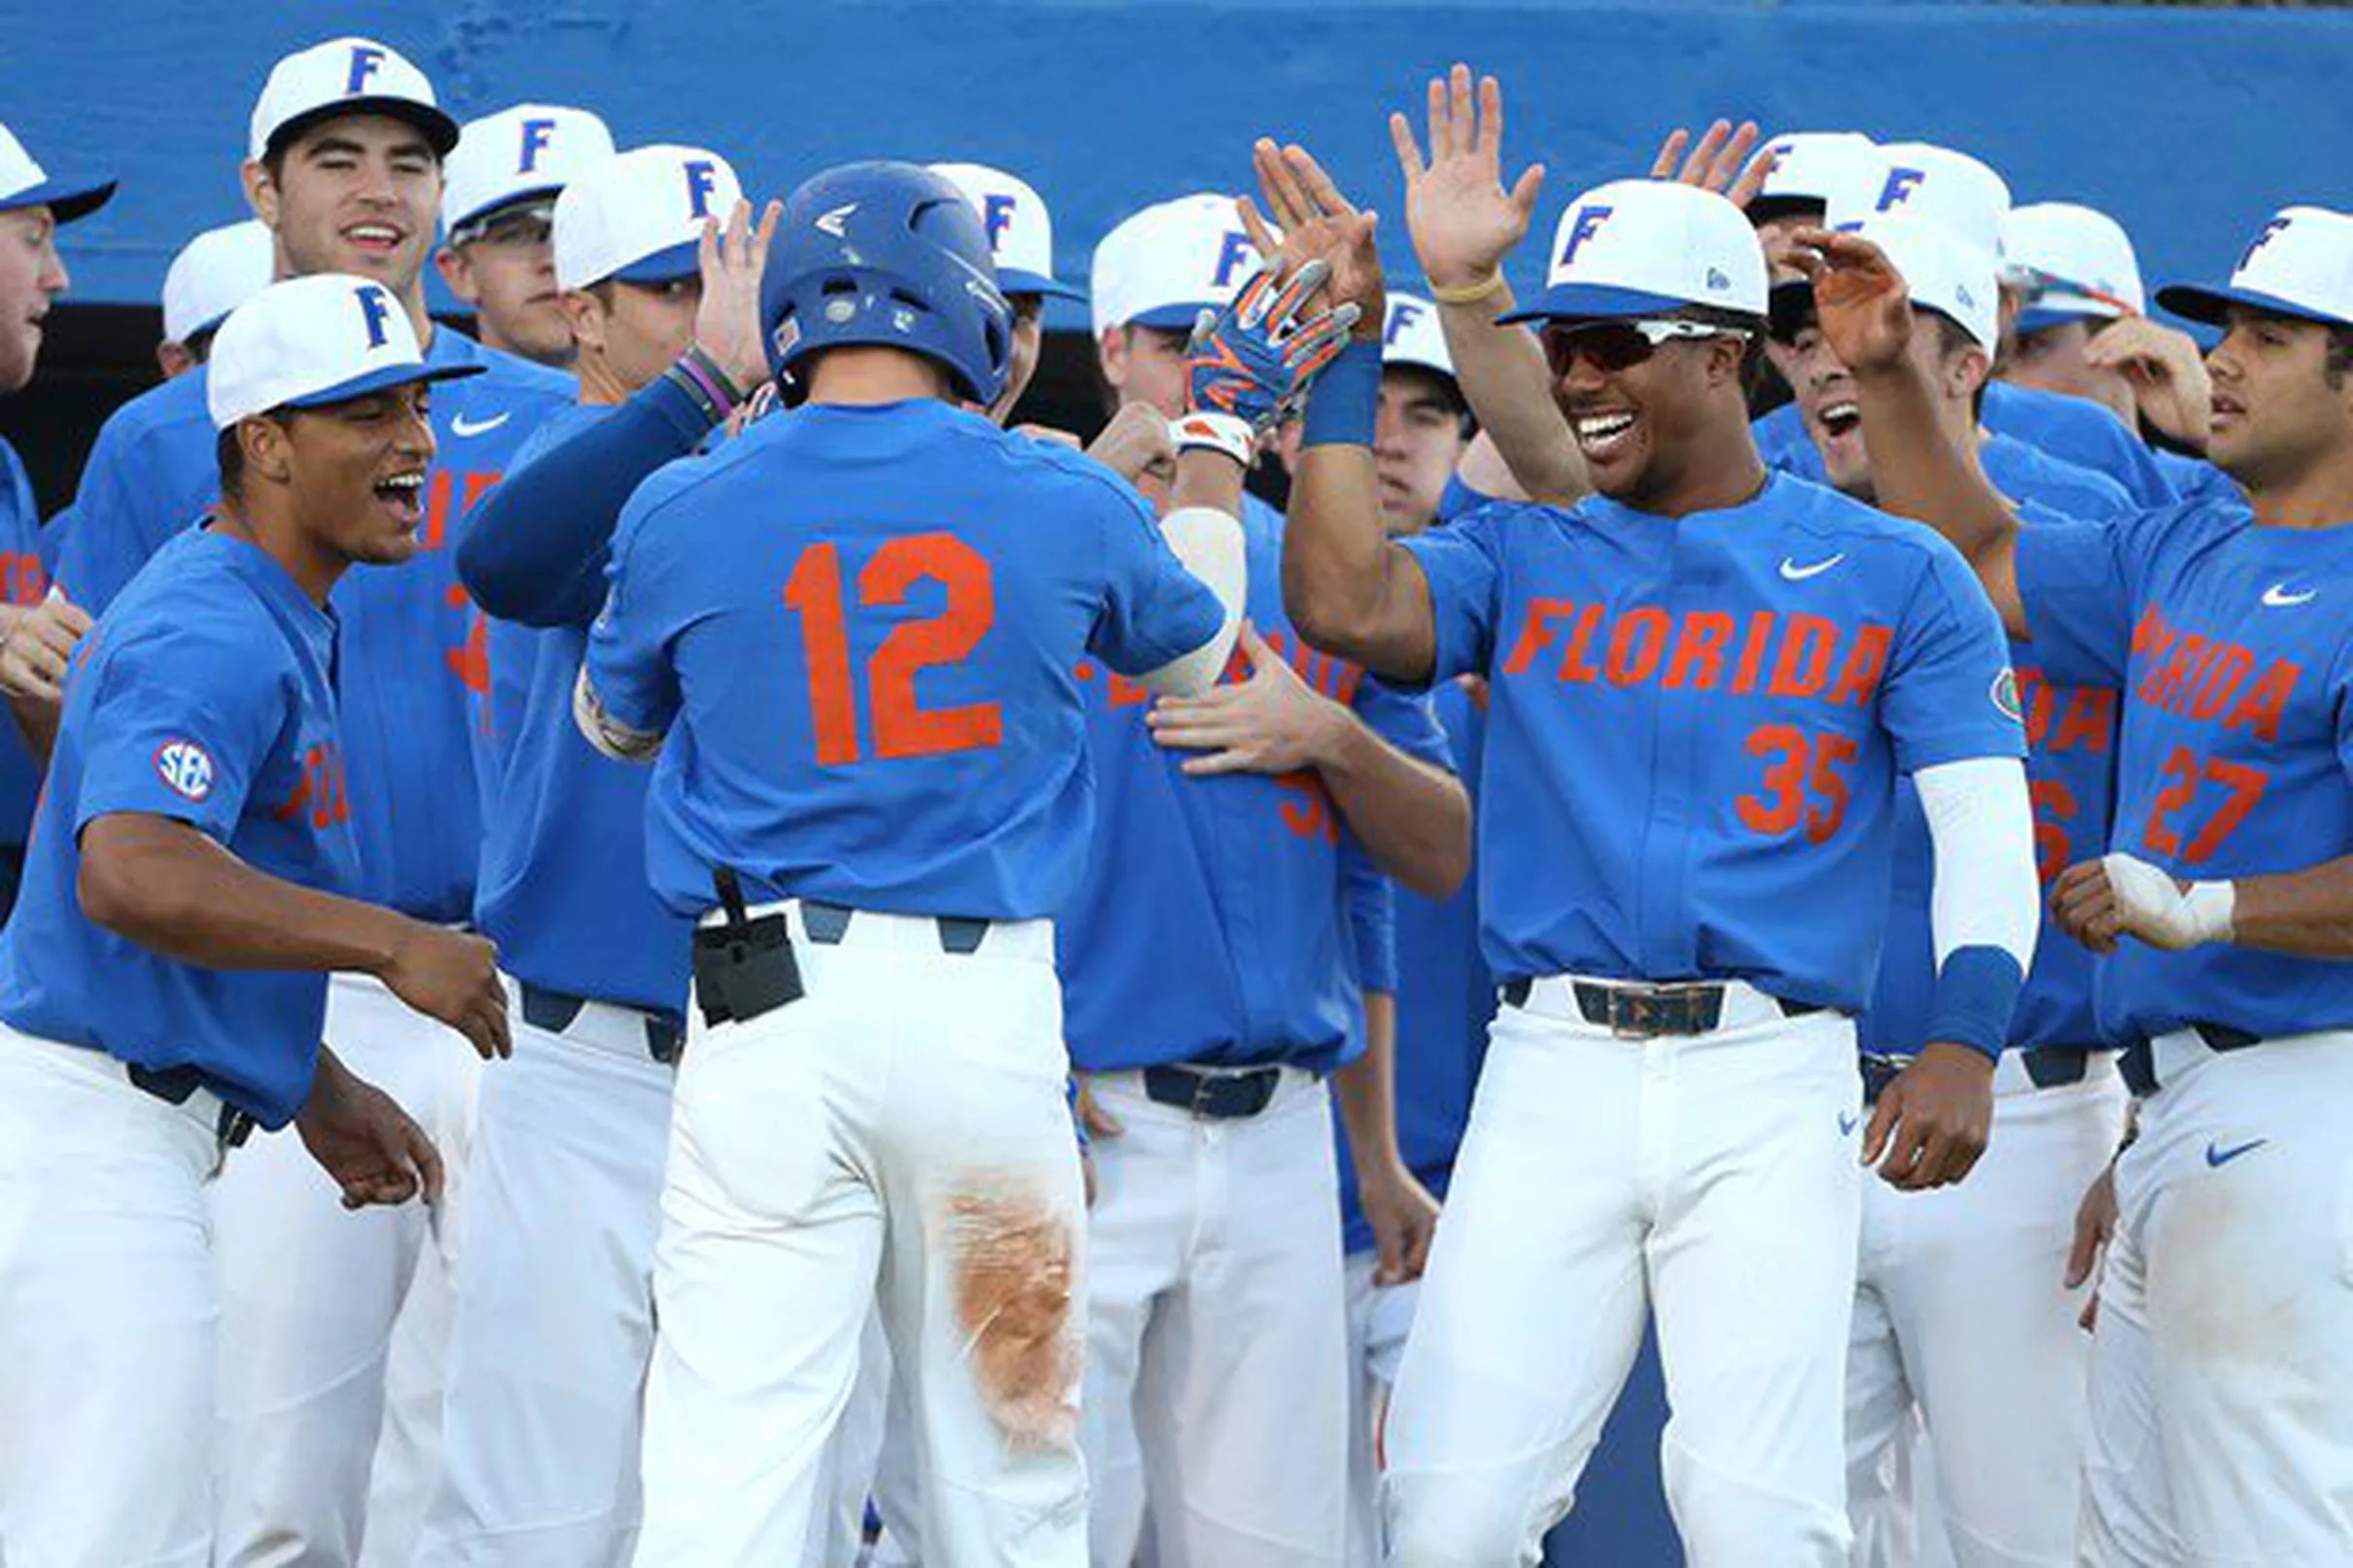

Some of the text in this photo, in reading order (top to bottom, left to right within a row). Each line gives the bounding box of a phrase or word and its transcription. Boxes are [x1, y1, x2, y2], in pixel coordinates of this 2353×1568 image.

[345, 47, 385, 94] F
[517, 119, 556, 174] F
[683, 160, 716, 220] F
[1876, 166, 1925, 213] F
[982, 194, 1017, 255] F
[1560, 205, 1614, 266] F
[2237, 217, 2293, 272] F
[1212, 229, 1252, 287] F
[353, 285, 390, 350] F
[1383, 303, 1423, 345] F
[783, 532, 1004, 766] 12
[1502, 596, 1895, 708] FLORIDA
[157, 742, 213, 800] SEC
[1735, 722, 1859, 846] 35
[2143, 746, 2269, 865] 27
